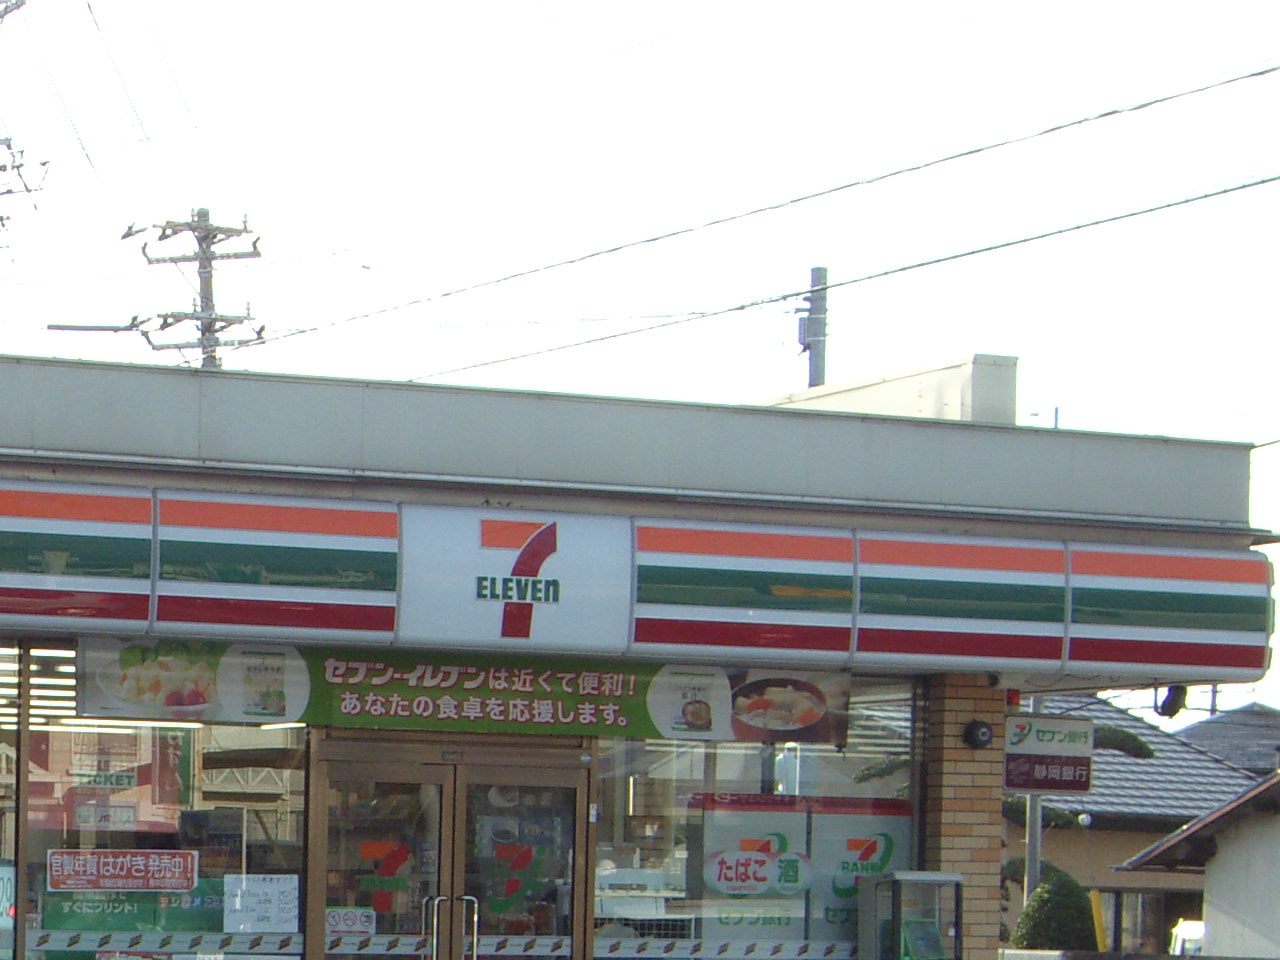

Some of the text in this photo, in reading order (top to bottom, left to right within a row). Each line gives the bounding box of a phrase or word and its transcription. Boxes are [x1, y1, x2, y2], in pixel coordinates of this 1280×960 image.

[481, 519, 558, 639] 7
[340, 691, 628, 727] あなたの食卓を応援します。
[1036, 728, 1089, 744] セブン銀行
[1034, 764, 1088, 781] 静岡銀行
[717, 857, 800, 884] たばこ 酒
